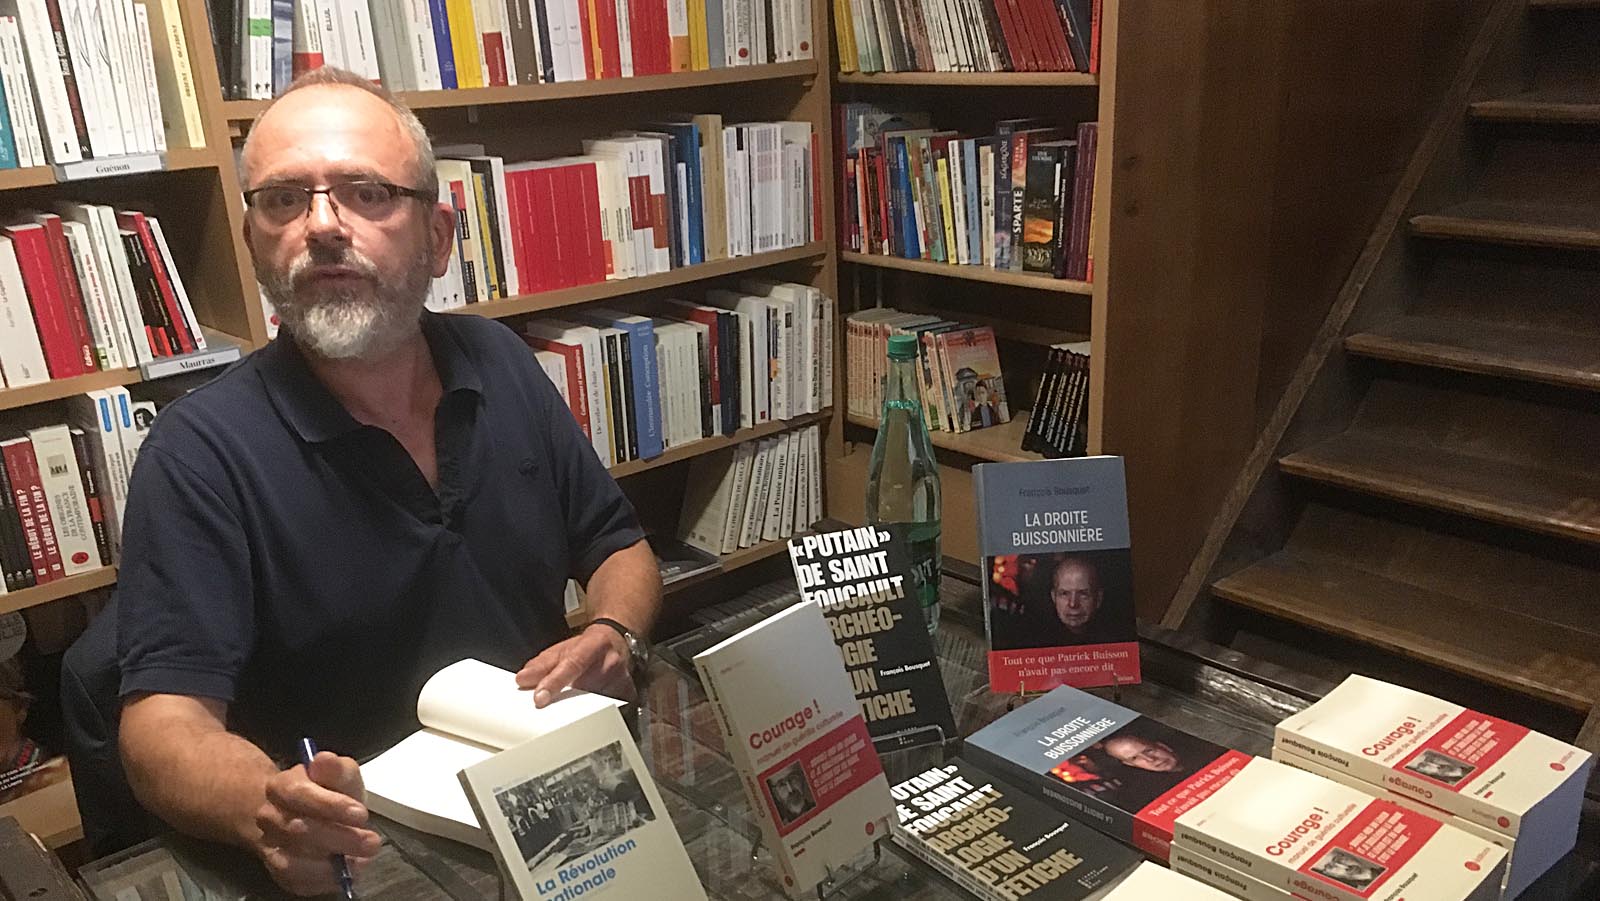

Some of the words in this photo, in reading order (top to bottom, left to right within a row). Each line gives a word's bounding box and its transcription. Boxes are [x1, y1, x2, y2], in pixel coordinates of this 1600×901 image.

[1012, 190, 1023, 233] SPARTE
[777, 454, 785, 479] unique
[773, 481, 781, 505] Pensée
[21, 507, 31, 516] LA
[35, 503, 45, 512] LA
[38, 513, 48, 522] DE
[772, 507, 779, 517] La
[1025, 514, 1041, 527] LA
[1044, 511, 1088, 526] DROITE
[23, 517, 34, 527] DE
[25, 527, 40, 550] DÉBUT
[40, 523, 54, 546] DÉBUT
[791, 526, 891, 559] «PUTAIN»
[1012, 526, 1104, 546] BUISSONNIÈRE
[32, 550, 42, 559] LE
[46, 545, 56, 554] LE
[800, 562, 826, 588] DE
[828, 551, 889, 584] SAINT
[824, 606, 902, 639] RCHÉO-
[841, 638, 878, 666] GIE
[1002, 656, 1023, 666] Tout
[1038, 656, 1055, 667] que
[1058, 651, 1089, 663] Patrick
[1092, 650, 1129, 660] Buisson
[880, 666, 904, 676] François
[904, 661, 931, 673] Bousquet
[1018, 667, 1048, 677] n'avait
[1050, 667, 1066, 678] pas
[1068, 665, 1099, 673] encore
[1101, 663, 1114, 672] dit
[852, 667, 878, 695] UN
[857, 689, 916, 723] TICHE
[750, 706, 814, 750] Courage
[1037, 732, 1058, 747] LA
[1056, 714, 1091, 739] DROITE
[1043, 717, 1116, 761] BUISSONNIÈRE
[1362, 722, 1414, 757] Courage
[1282, 737, 1315, 755] Bousquet
[1316, 750, 1349, 767] François
[890, 764, 958, 802] UTAIN»
[1166, 799, 1176, 808] ce
[1175, 789, 1191, 804] que
[1188, 772, 1214, 795] Patrick
[1212, 756, 1240, 778] Buisson
[1389, 777, 1433, 799] Courage
[910, 776, 975, 817] SAINT
[906, 783, 1003, 838] FOUCAULT
[1023, 836, 1046, 852] François
[1045, 821, 1070, 841] Bousquet
[1181, 834, 1217, 853] Bousquet
[1265, 810, 1323, 858] Courage
[950, 831, 1015, 868] LOGIE
[1217, 847, 1252, 868] François
[536, 879, 556, 896] La
[558, 838, 637, 885] Révolution
[970, 850, 1031, 884] D'UN
[1177, 855, 1213, 876] Bousquet
[1213, 869, 1247, 891] François
